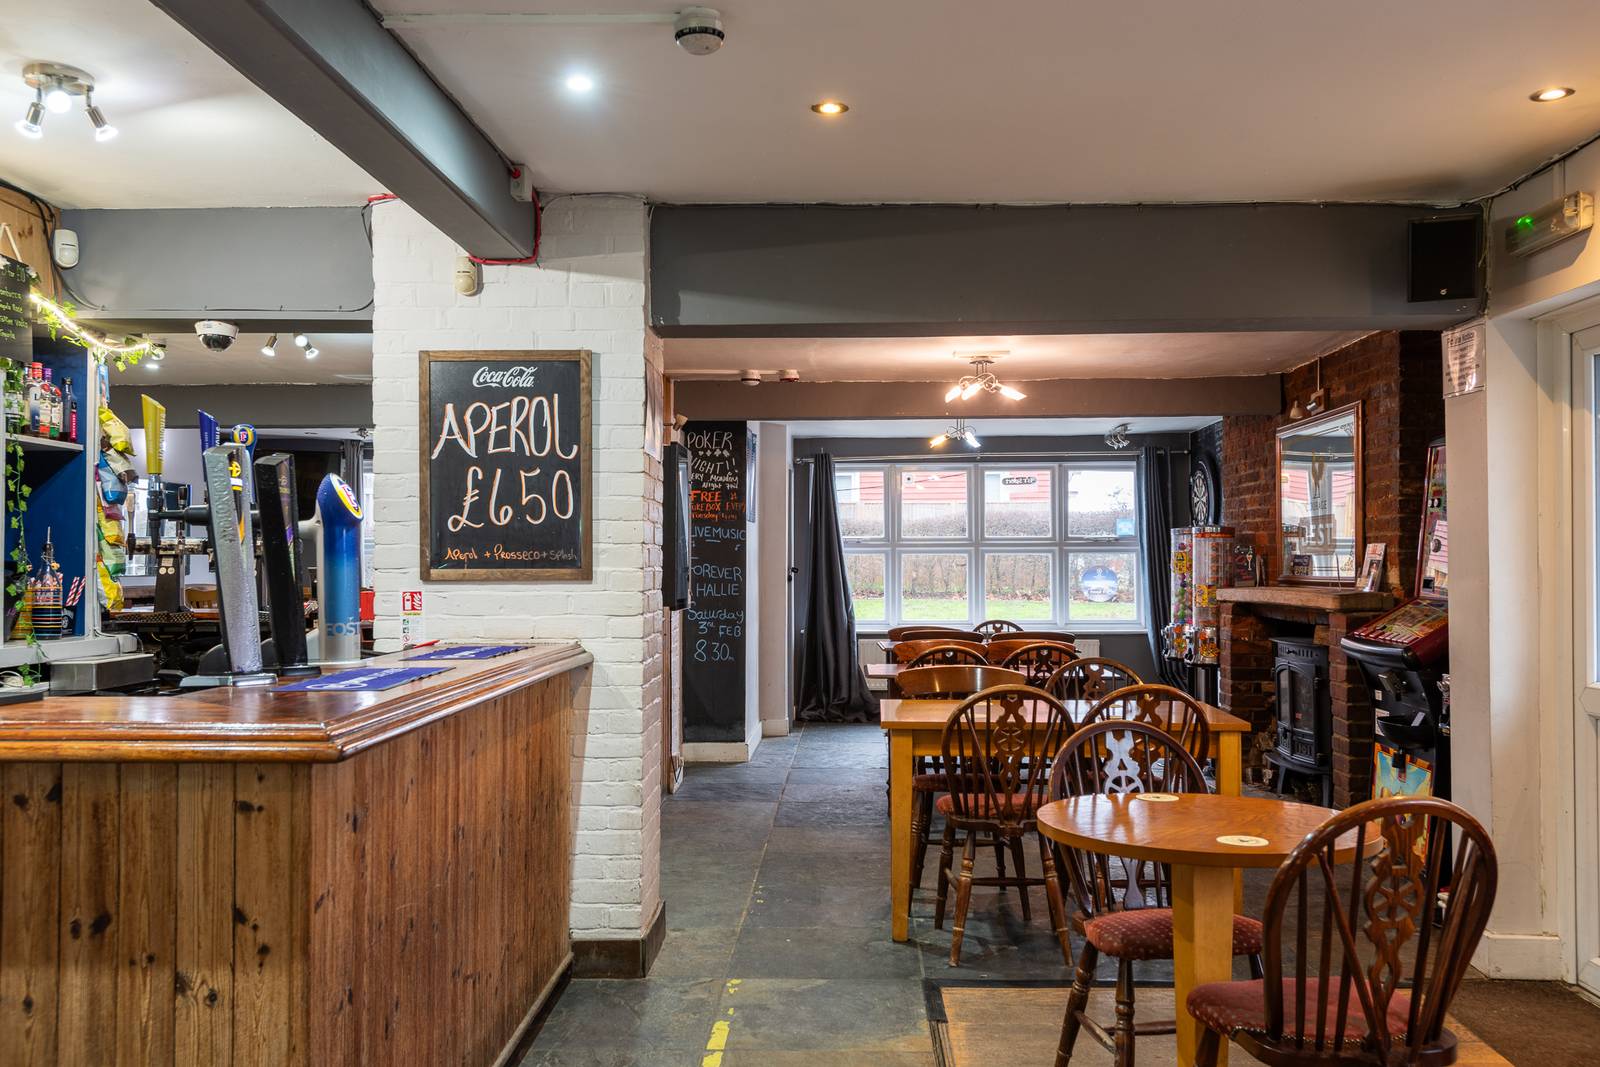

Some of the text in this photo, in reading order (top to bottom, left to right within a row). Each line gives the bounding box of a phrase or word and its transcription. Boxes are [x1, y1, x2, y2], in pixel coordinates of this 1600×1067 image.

[472, 366, 538, 388] Coca-Cola
[431, 393, 578, 460] APEROL
[687, 430, 733, 450] POKER
[690, 490, 721, 502] FREE
[712, 527, 746, 541] MUSIC
[696, 583, 740, 597] HALLIE
[687, 608, 744, 625] Saturday
[719, 625, 742, 638] FEB
